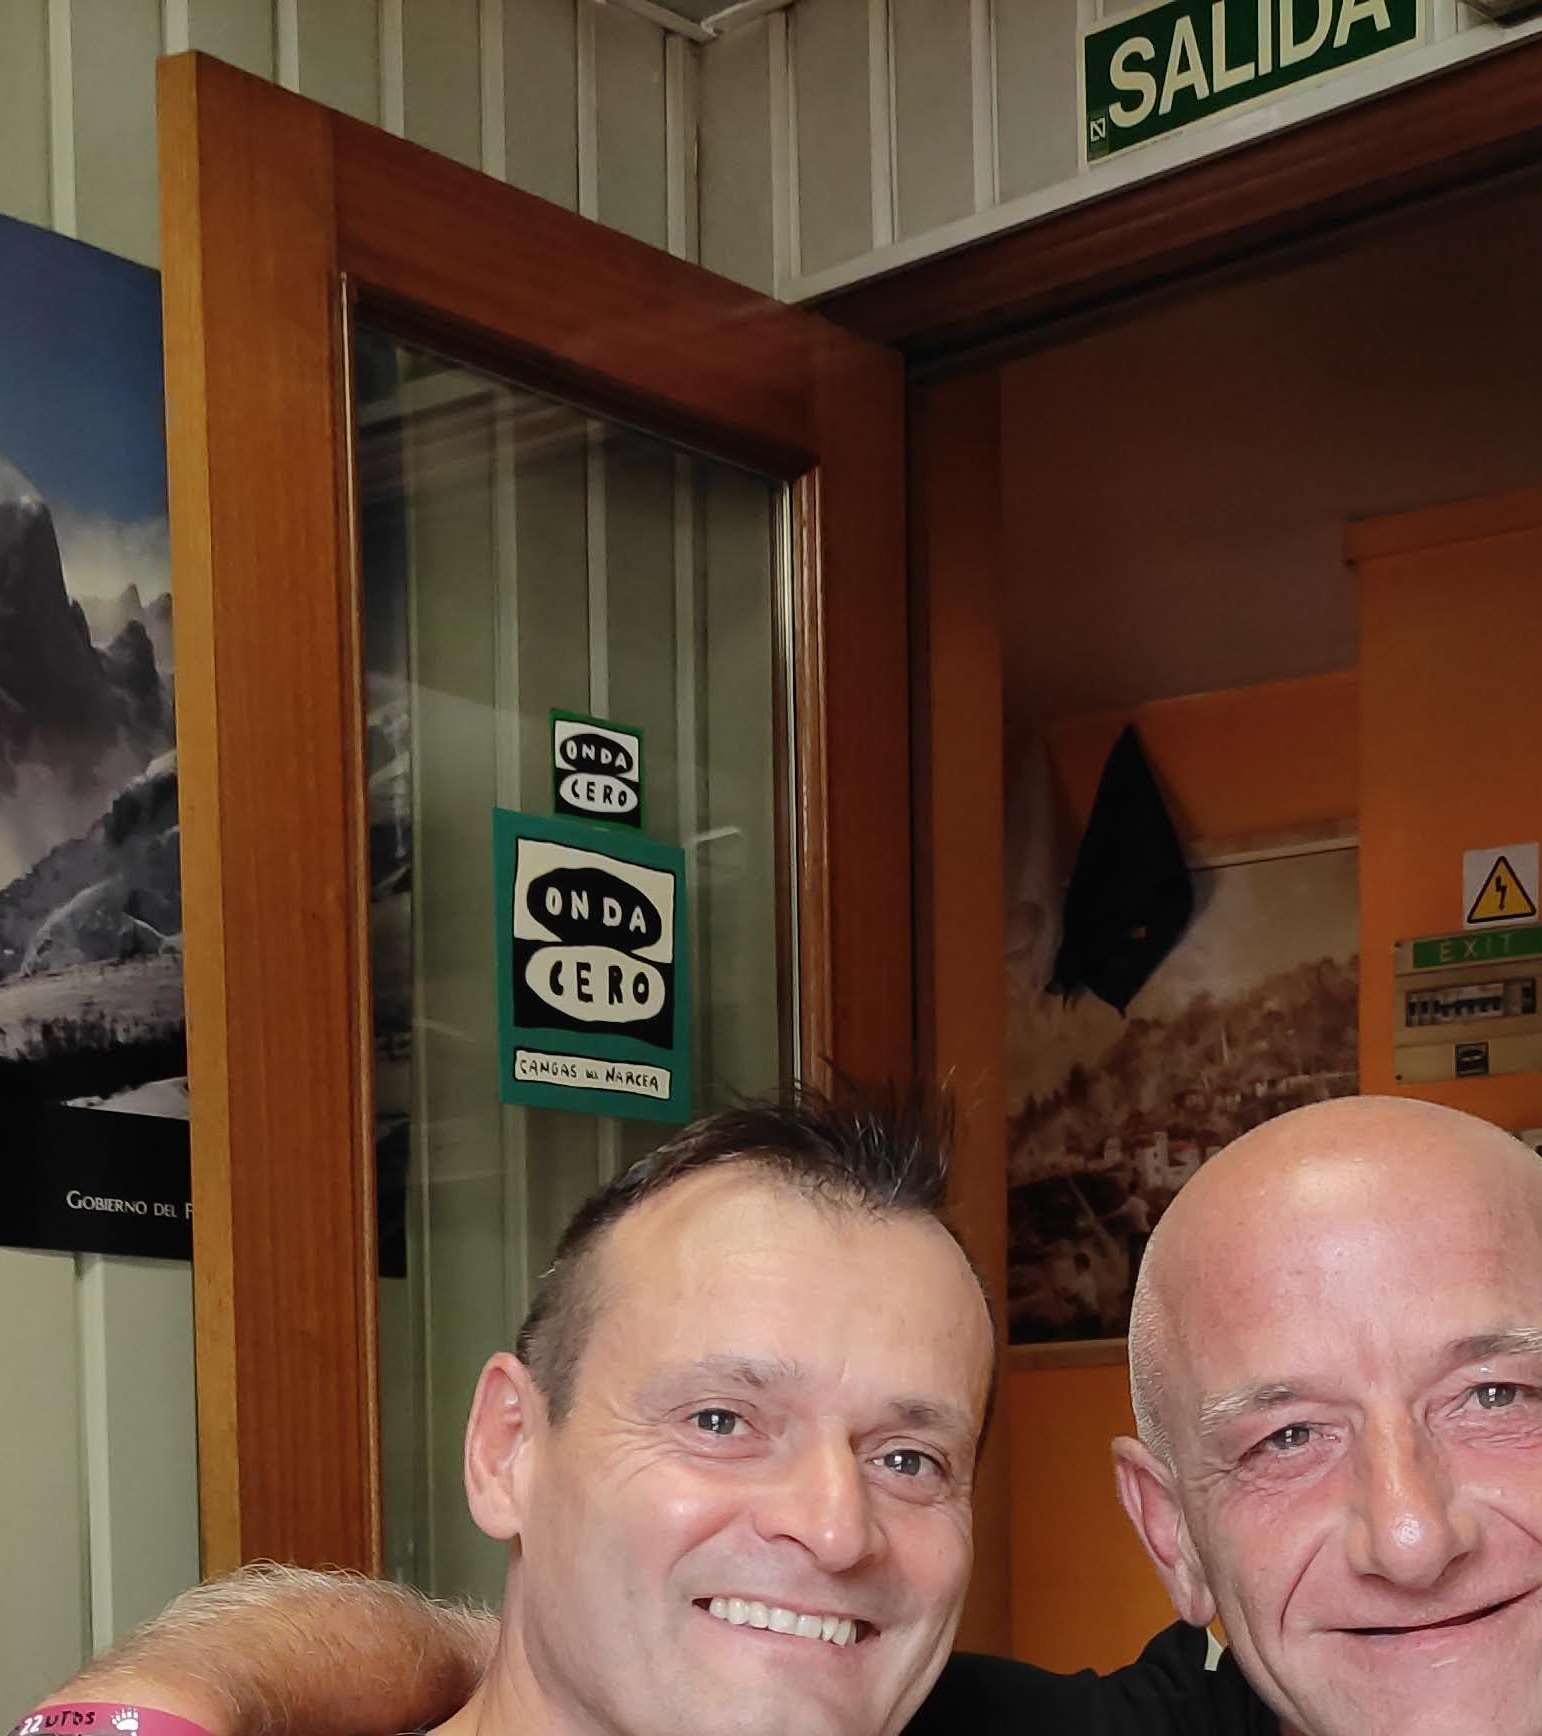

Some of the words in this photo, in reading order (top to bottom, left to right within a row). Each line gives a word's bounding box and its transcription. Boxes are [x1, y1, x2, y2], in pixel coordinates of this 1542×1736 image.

[565, 740, 628, 771] ONDA
[570, 778, 628, 807] CERO
[545, 886, 647, 935] ONDA
[1440, 934, 1514, 962] EXIT
[549, 960, 650, 1005] CERO
[519, 1059, 578, 1079] CANGAS
[605, 1066, 659, 1092] NARCEA
